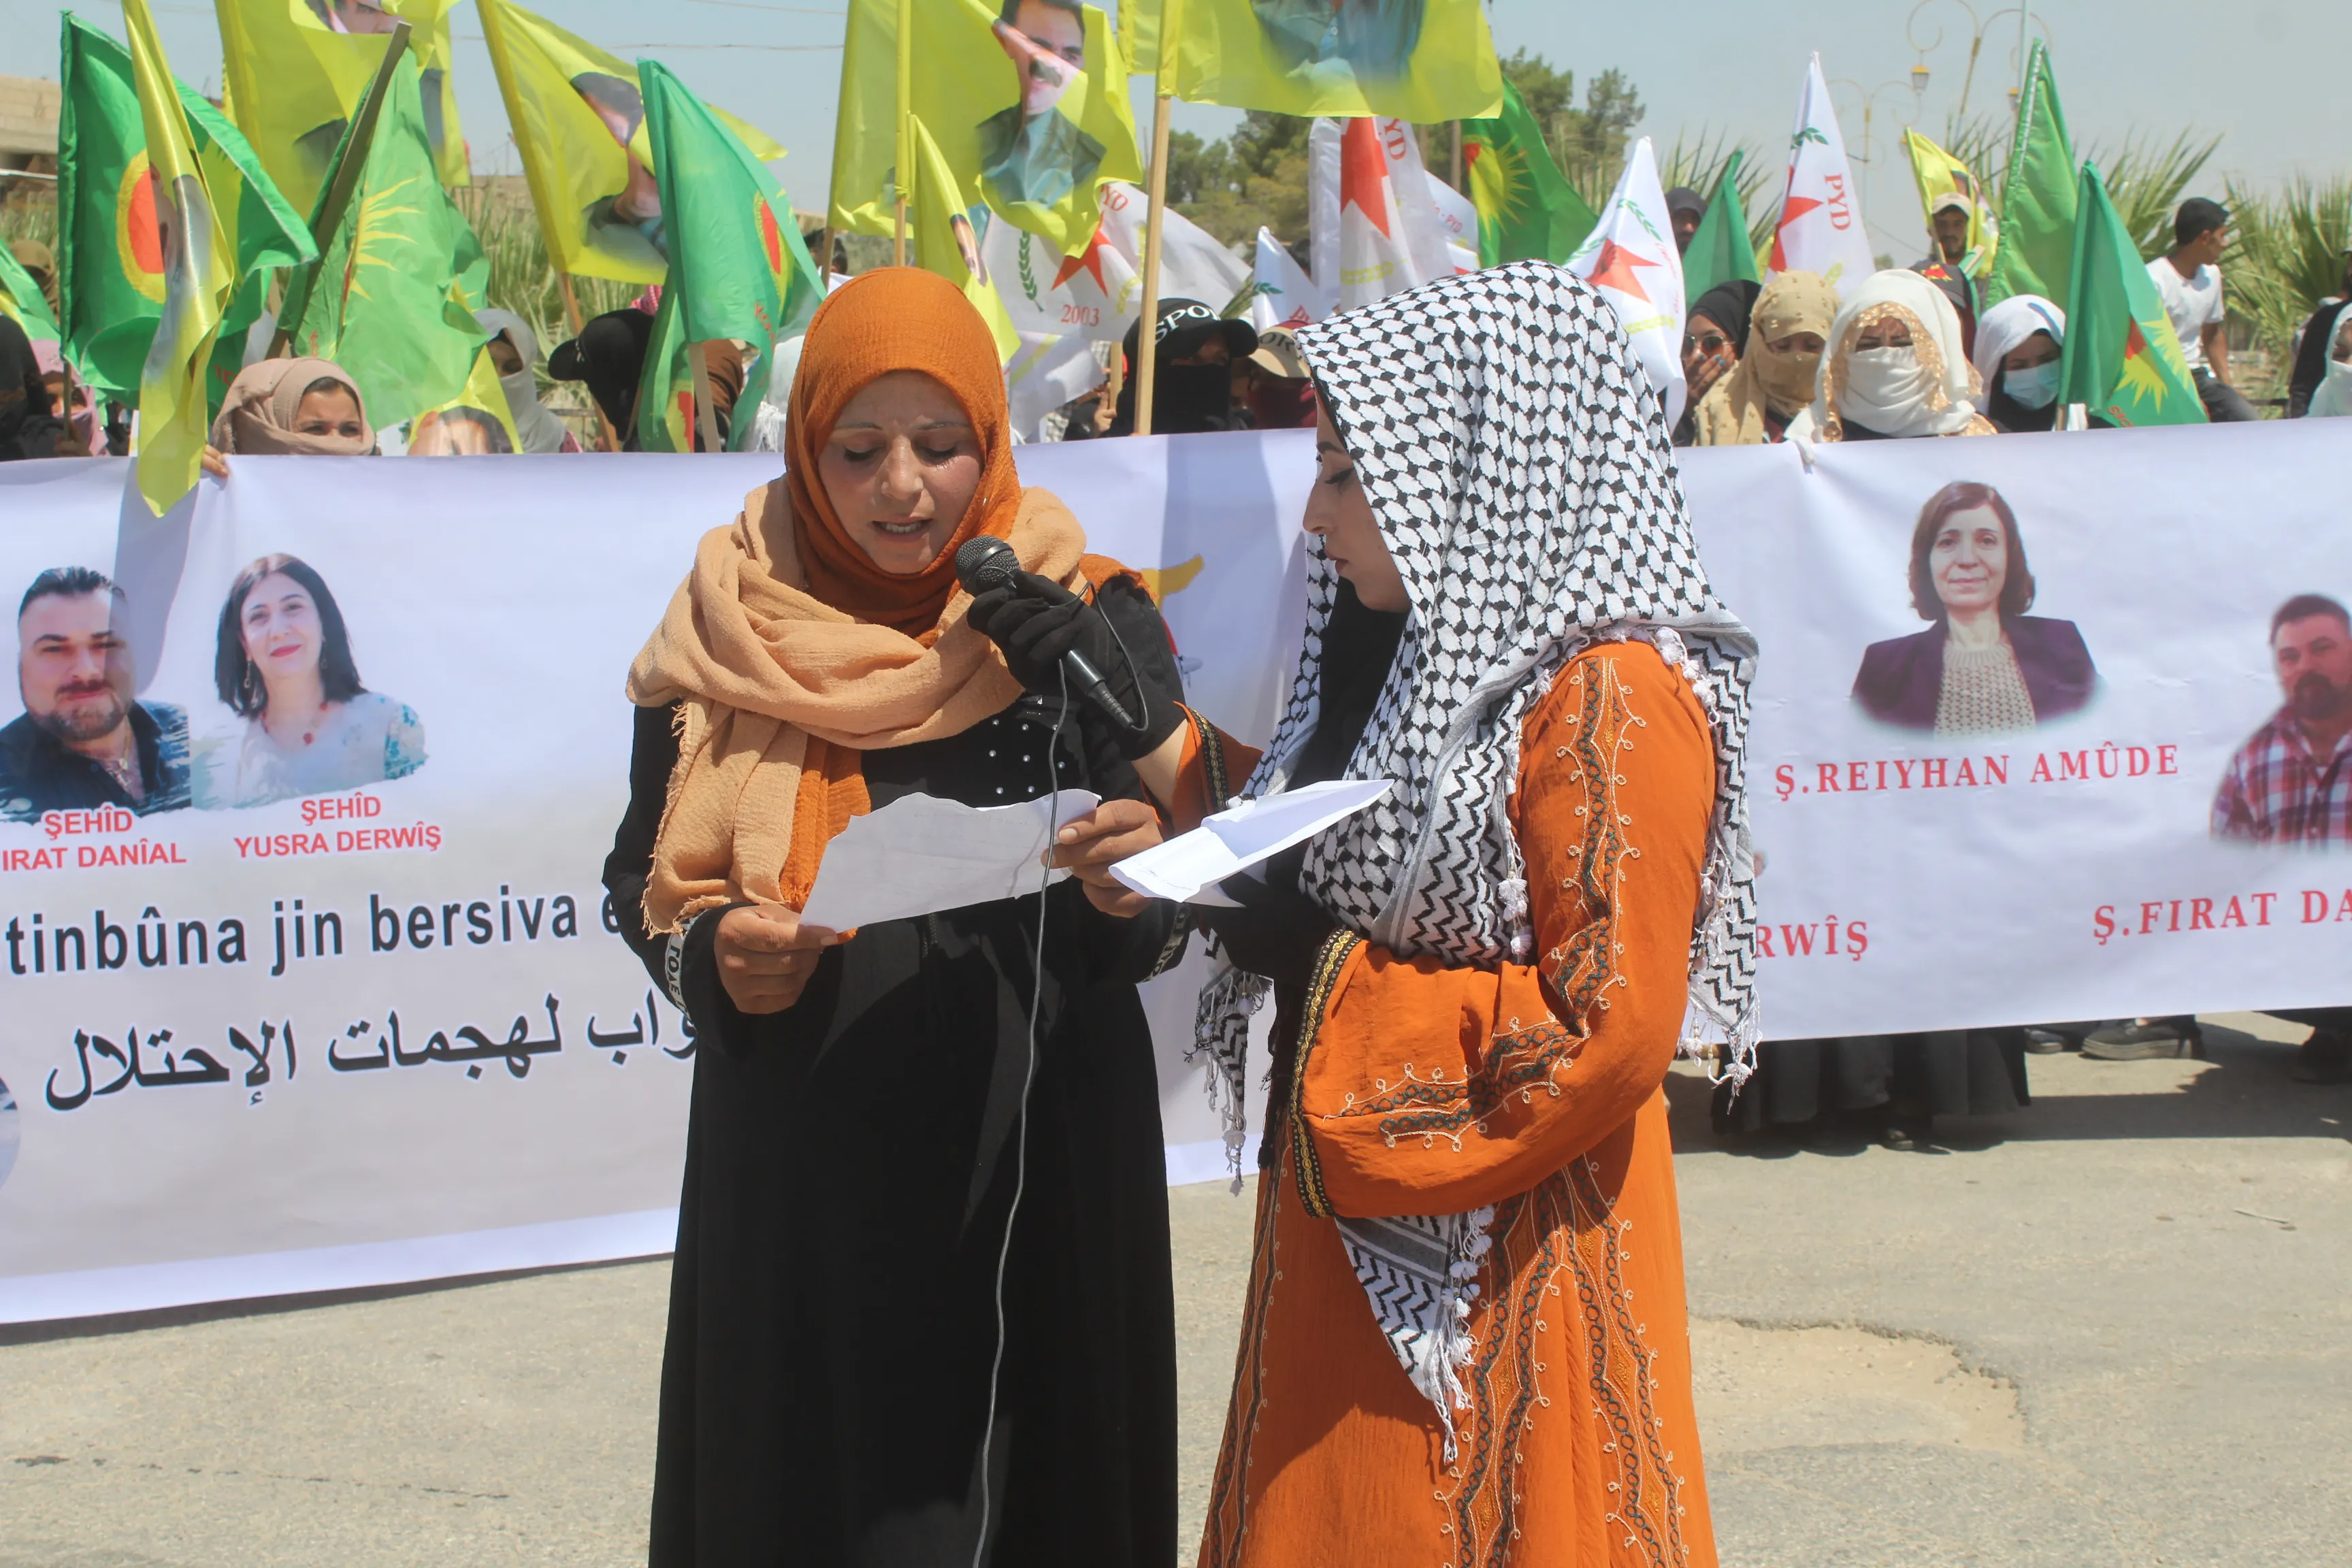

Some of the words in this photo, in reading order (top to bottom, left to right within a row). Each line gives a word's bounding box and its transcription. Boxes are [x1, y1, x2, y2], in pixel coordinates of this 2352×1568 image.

[1384, 118, 1407, 161] YD
[1100, 184, 1128, 212] YD
[1825, 174, 1850, 231] PYD
[1061, 304, 1100, 327] 2003
[1775, 755, 2009, 802] Ş.REIYHAN
[2031, 741, 2178, 783] AMÛDE
[45, 806, 133, 840] ŞEHÎD
[302, 792, 382, 826] ŞEHÎD
[3, 848, 68, 871] IRAT
[78, 838, 187, 868] DANÎAL
[234, 833, 329, 858] YUSRA
[337, 819, 442, 855] DERWÎŞ
[5, 906, 247, 975] tinbûna
[272, 900, 343, 977] jin
[370, 885, 578, 952] bersiva
[1756, 914, 1868, 962] RWÎŞ
[2093, 892, 2277, 947] Ş.FIRAT
[2300, 889, 2352, 924] DA
[328, 993, 563, 1080] لهجمات
[46, 1020, 297, 1111] الإحتلال
